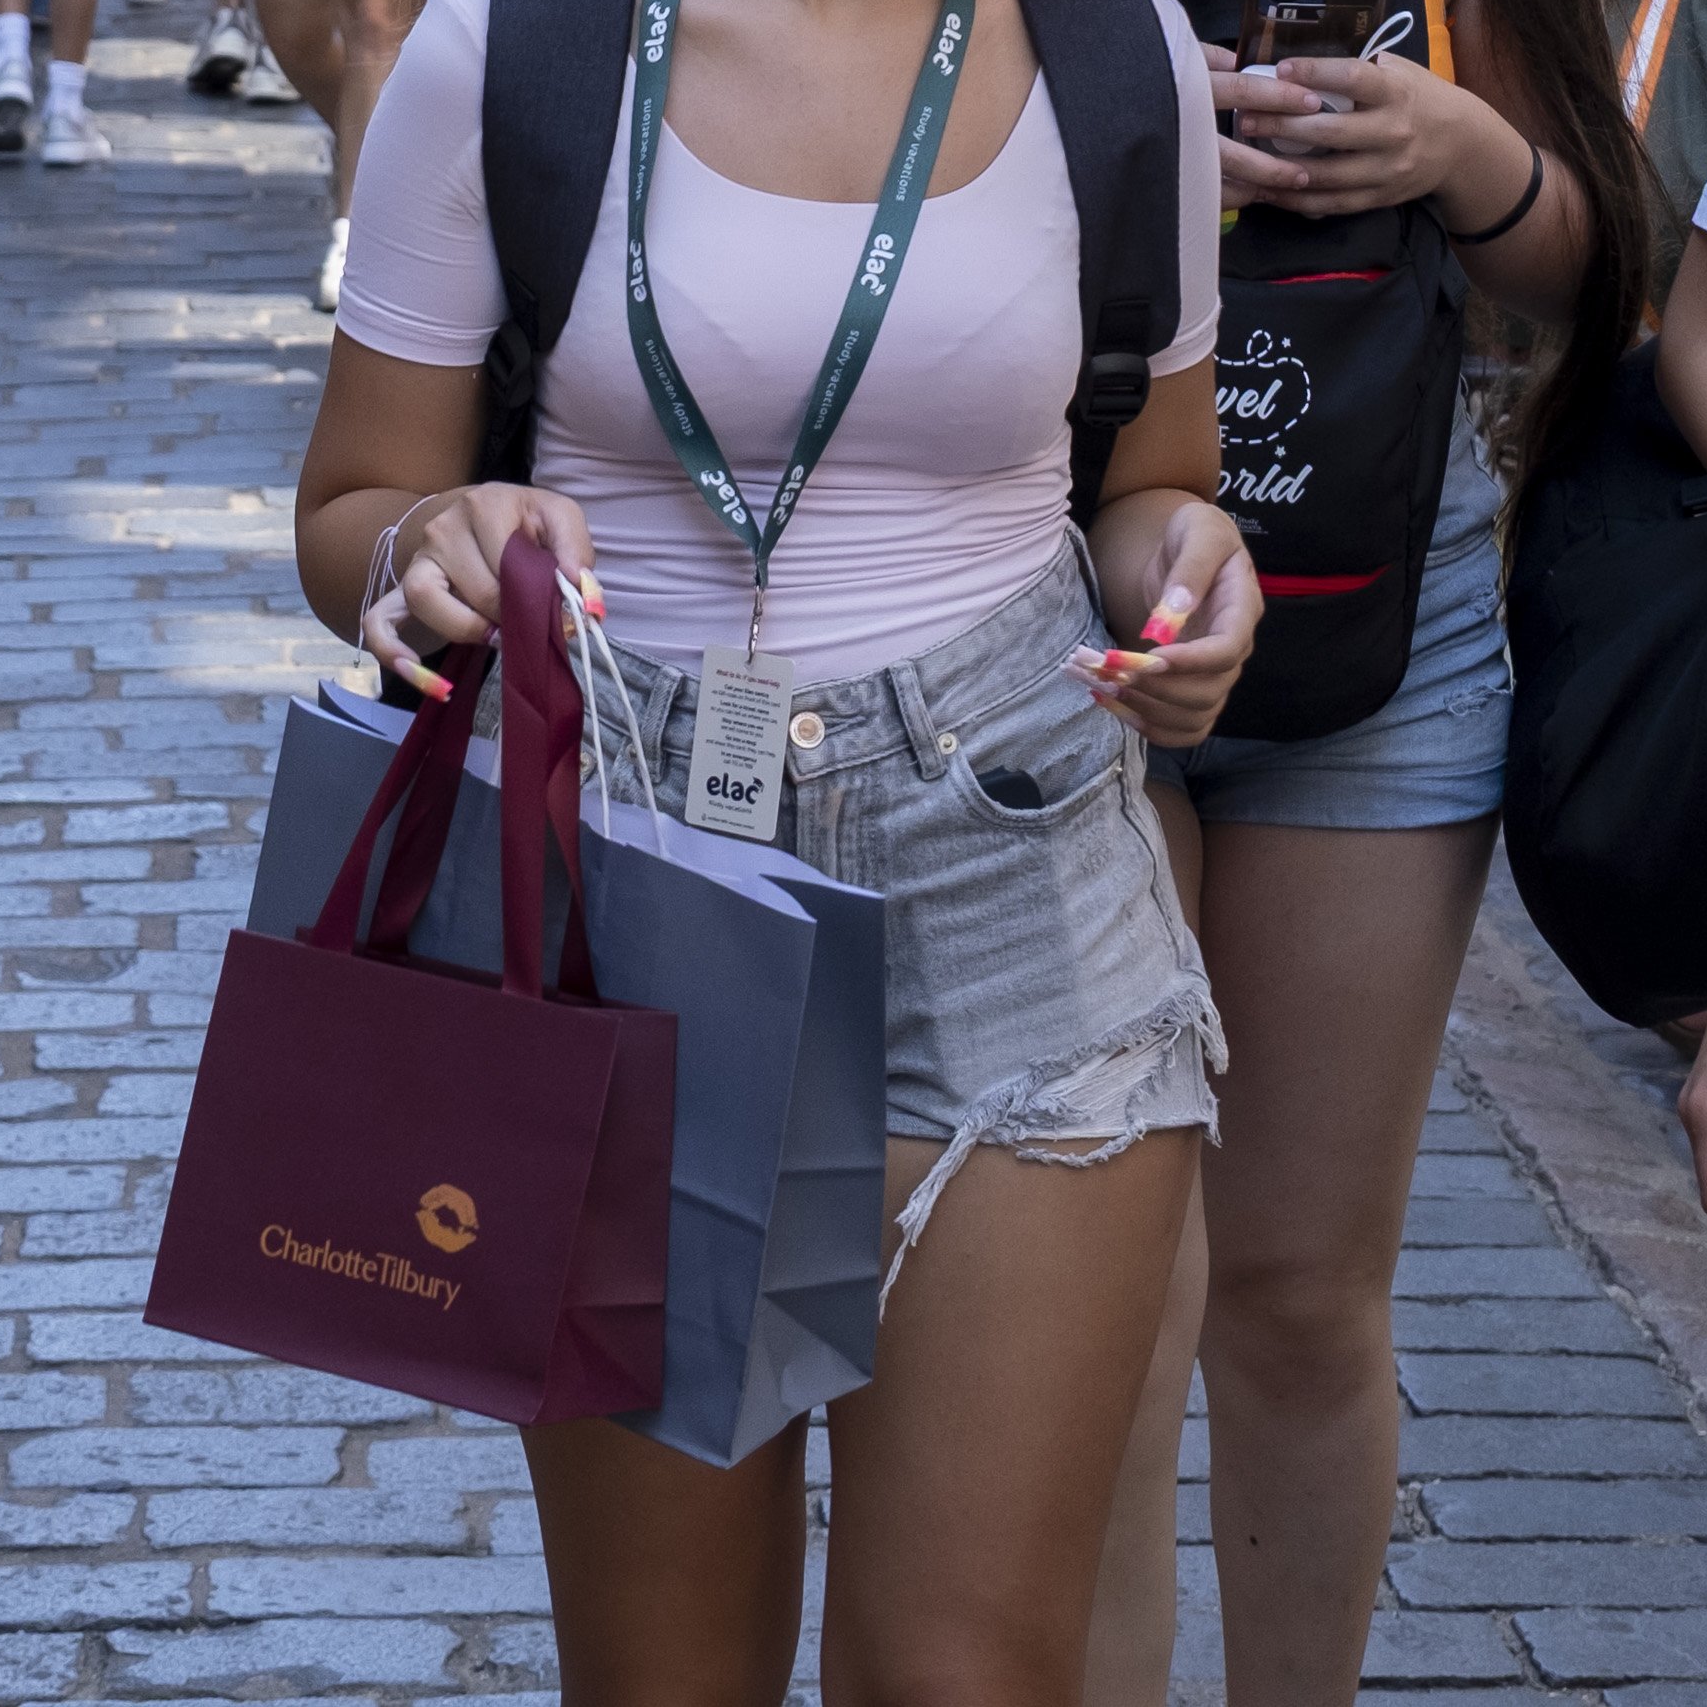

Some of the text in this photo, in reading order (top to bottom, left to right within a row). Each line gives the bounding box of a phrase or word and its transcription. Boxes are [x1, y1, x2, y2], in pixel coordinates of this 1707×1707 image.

[644, 1, 671, 63] elac
[933, 12, 962, 76] elac
[1355, 11, 1368, 36] VISA
[896, 105, 933, 202] study vacations
[629, 240, 647, 303] elac
[861, 233, 895, 296] elac
[813, 329, 859, 431] study vacations
[1216, 379, 1283, 420] vel
[673, 403, 694, 436] study
[701, 470, 747, 524] elac
[773, 465, 804, 525] elac
[706, 772, 764, 805] elac
